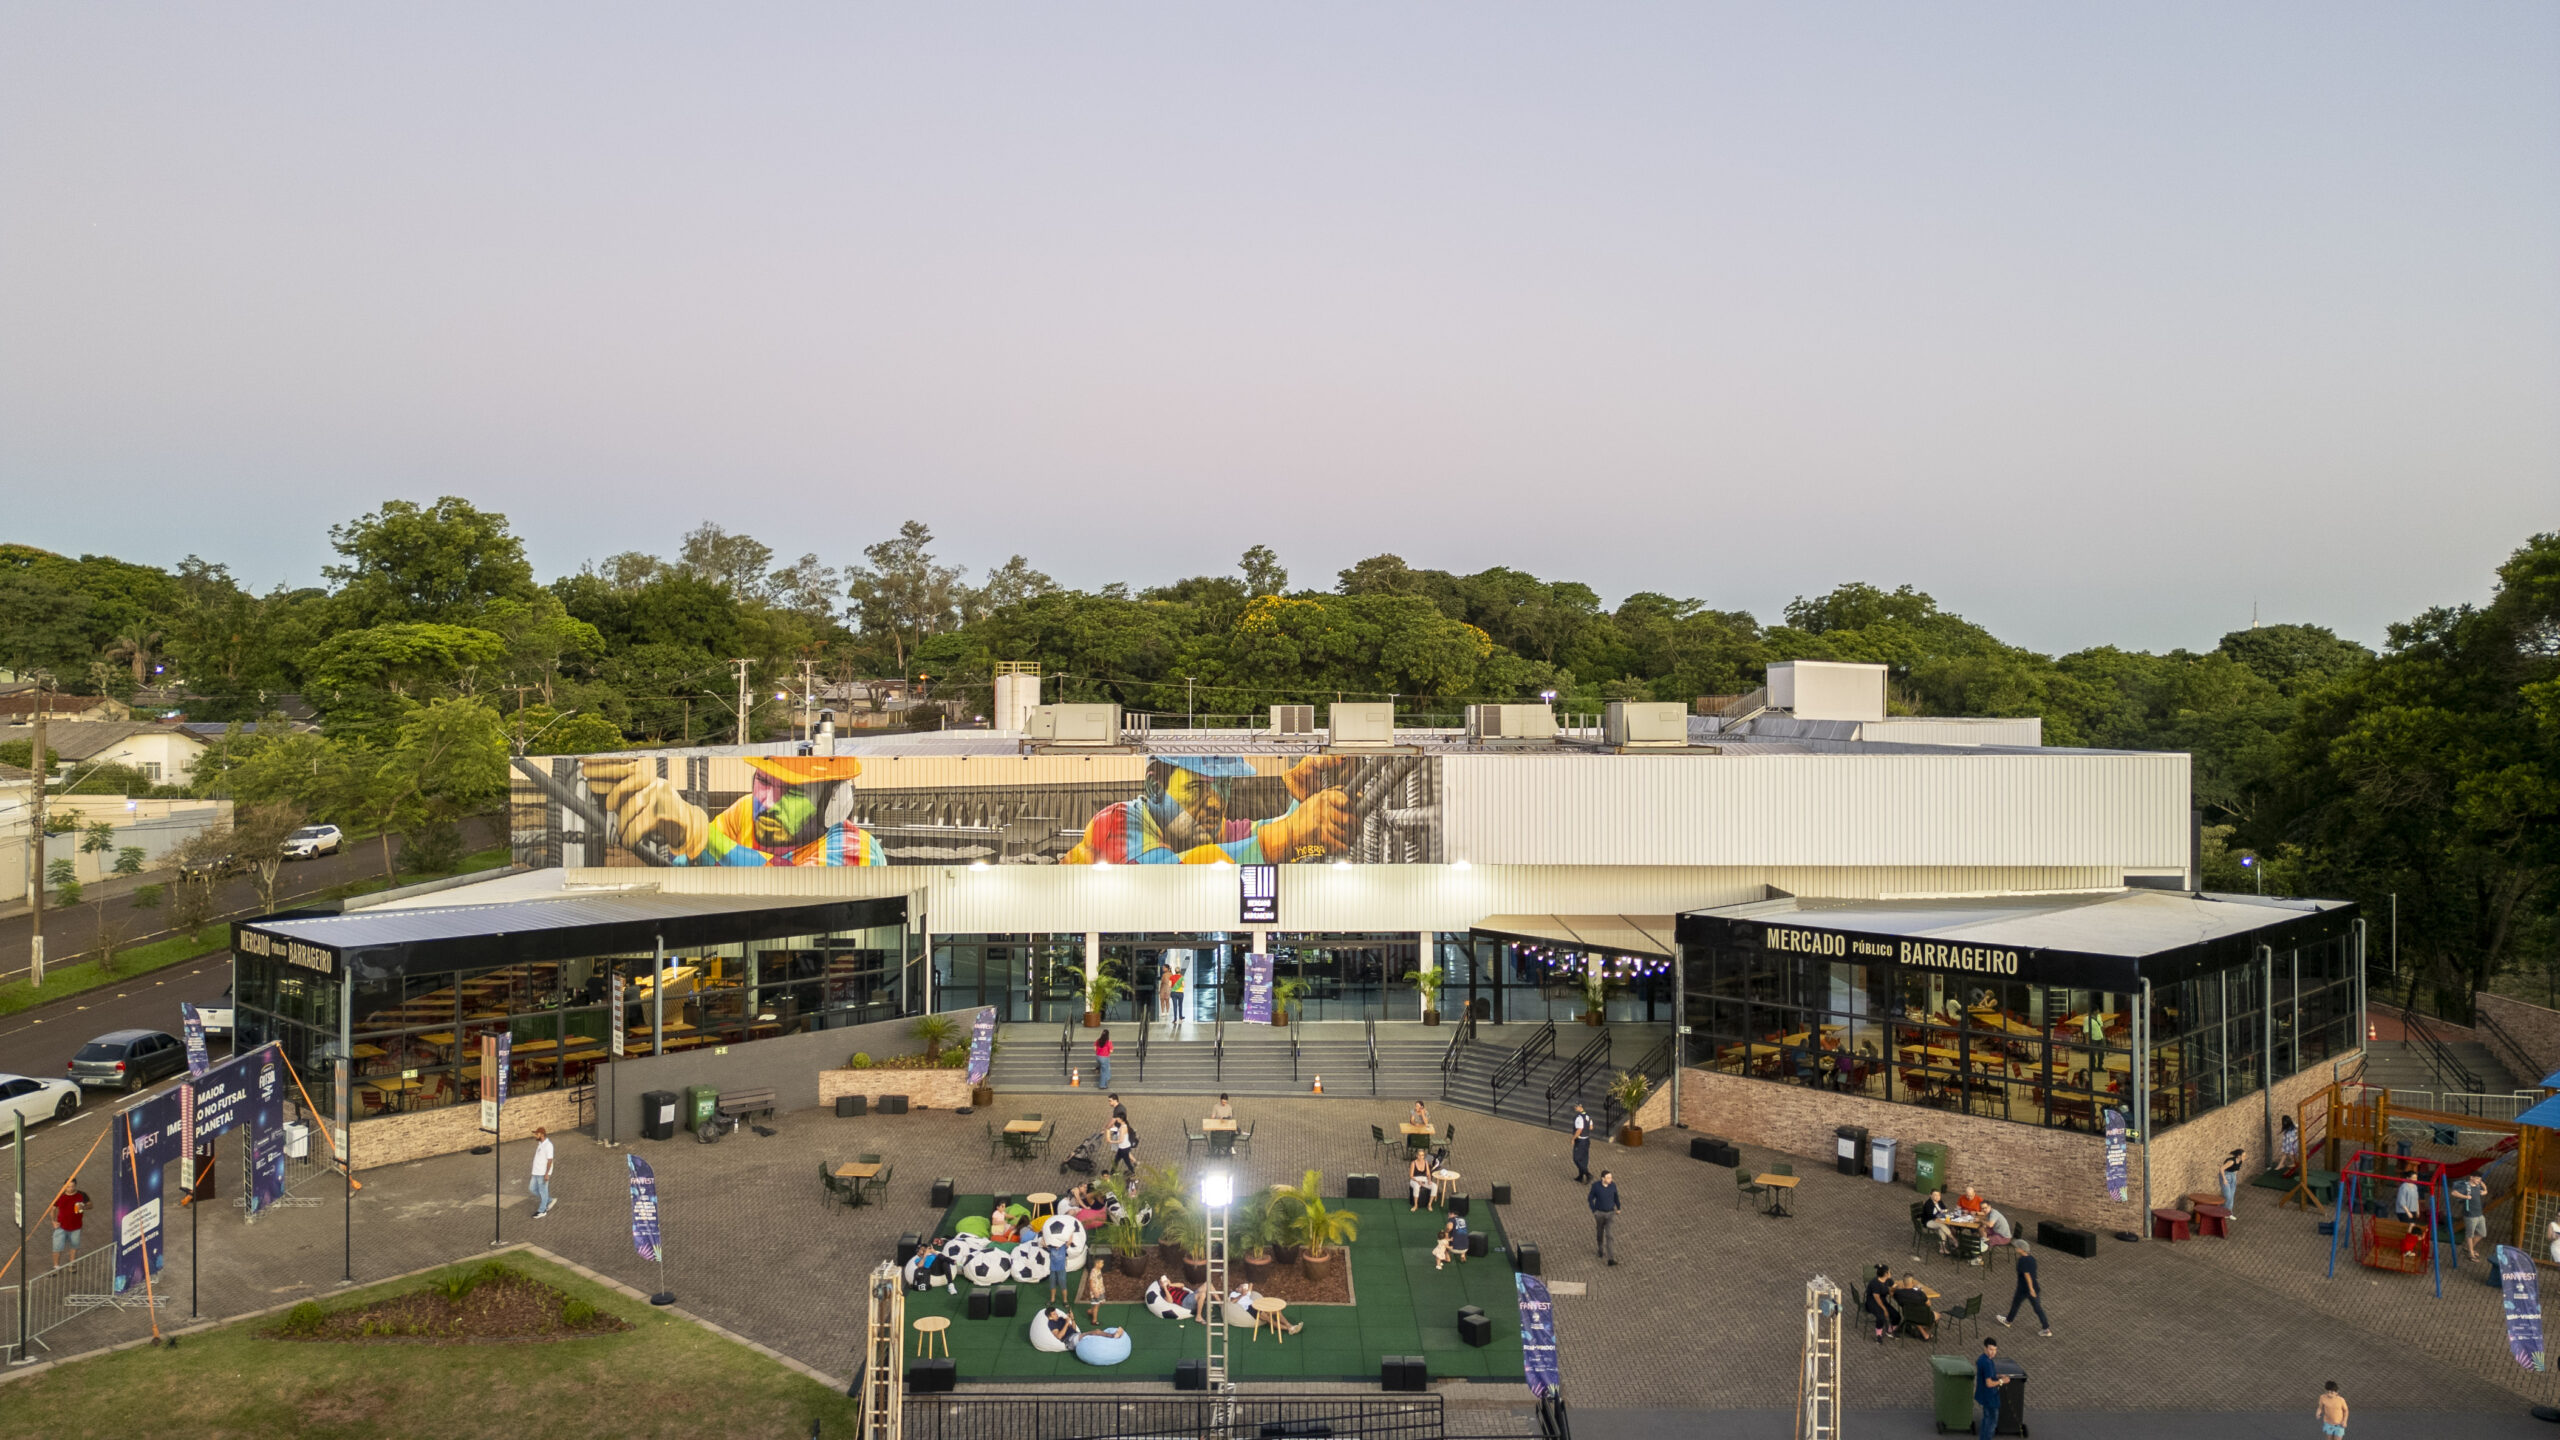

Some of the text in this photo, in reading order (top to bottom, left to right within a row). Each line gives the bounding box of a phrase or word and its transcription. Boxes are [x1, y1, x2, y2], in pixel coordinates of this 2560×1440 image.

[240, 929, 270, 958] MERCADO
[288, 941, 332, 974] BARRAGEIRO
[1766, 927, 2018, 975] MERCADO PÚBLICO BARRAGEIRO
[198, 1083, 225, 1105] MAIOR
[204, 1102, 217, 1118] NO
[217, 1088, 247, 1111] FUTSAL
[195, 1109, 234, 1139] PLANETA!
